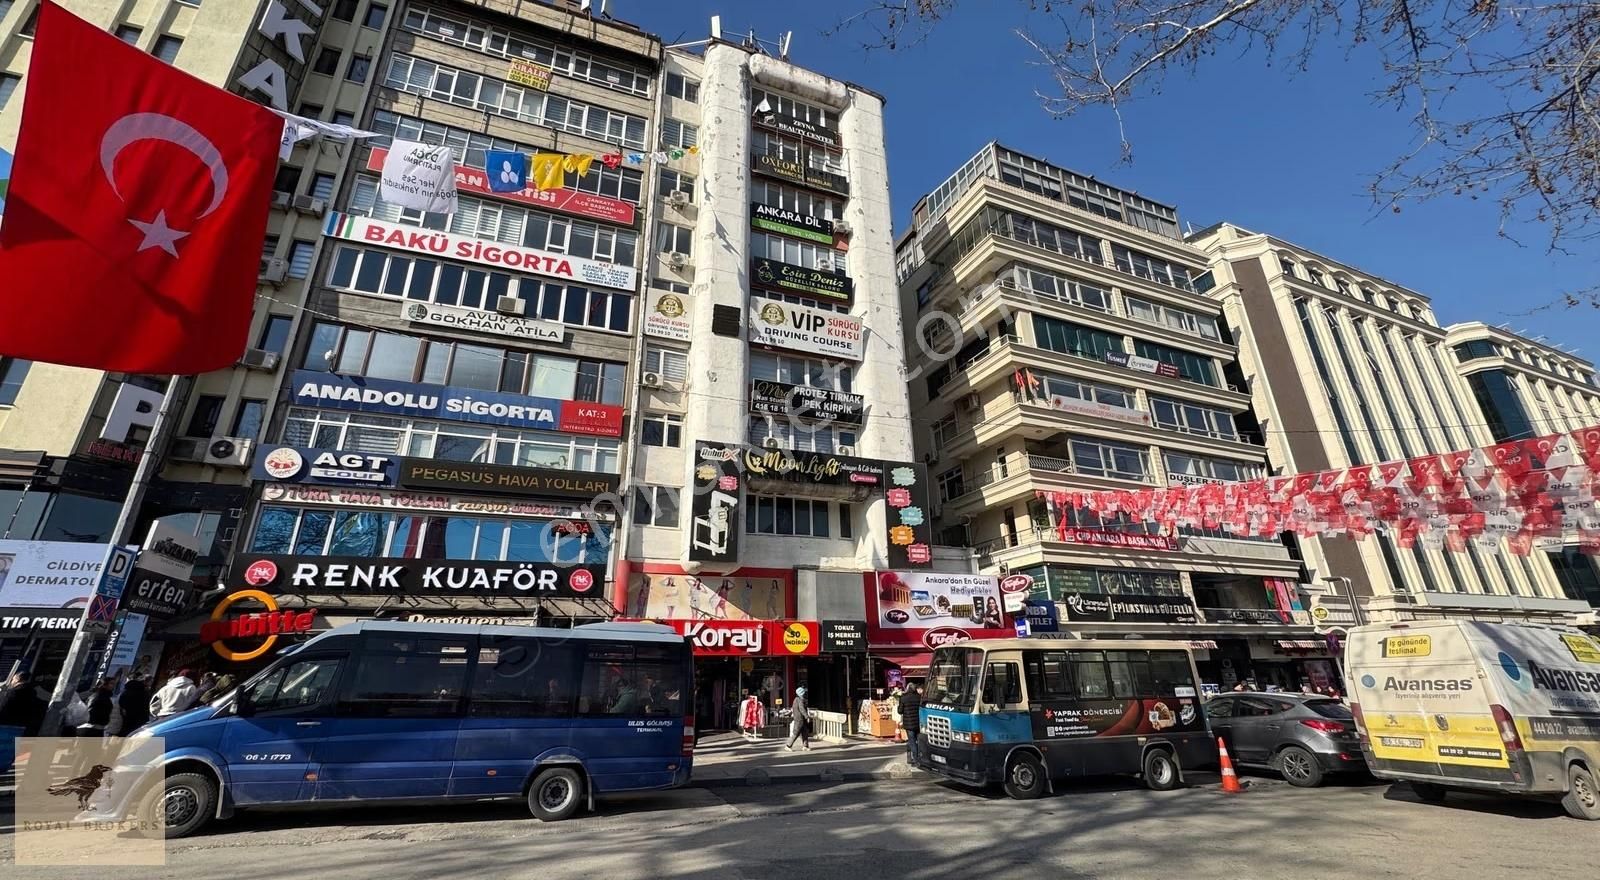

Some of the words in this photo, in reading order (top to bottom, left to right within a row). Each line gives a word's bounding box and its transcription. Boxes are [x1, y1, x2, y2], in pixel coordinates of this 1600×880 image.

[511, 61, 549, 79] KIRALIK
[778, 122, 806, 136] BEAUTY
[806, 131, 835, 145] CENTER
[793, 120, 816, 132] ZEYNA
[756, 204, 802, 223] ANKARA
[805, 215, 822, 228] DİL
[364, 223, 450, 253] BAKÜ
[455, 240, 574, 277] SİGORTA
[781, 266, 807, 280] Esin
[810, 272, 845, 288] Deniz
[430, 313, 506, 331] GÖKHAN
[514, 326, 559, 339] ATİLA
[466, 311, 530, 326] AVUKAT
[648, 316, 670, 325] SÜRÜCÜ
[671, 321, 690, 329] KURSU
[791, 310, 826, 333] VİP
[828, 317, 860, 332] SÜRÜCÜ
[764, 327, 809, 342] DRIVING
[812, 335, 853, 350] COURSE
[827, 327, 859, 341] KURSU
[298, 383, 438, 411] ANADOLU
[446, 395, 555, 423] SİGORTA
[794, 386, 828, 399] PROTEZ
[829, 391, 861, 404] TIRNAK
[100, 382, 166, 443] P
[578, 408, 607, 419] KAT:3
[801, 397, 822, 410] İPEK
[823, 402, 853, 415] KİRPİK
[815, 411, 831, 419] KAT
[313, 452, 389, 470] AGT
[763, 451, 805, 474] Moon
[807, 455, 841, 481] Light
[322, 469, 379, 480] tour
[411, 467, 496, 485] PEGASUS
[498, 472, 541, 488] HAVA
[543, 476, 610, 494] YOLLARI
[288, 487, 334, 503] TÜRK
[338, 489, 385, 506] HAVA
[1076, 531, 1091, 542] CHP
[1091, 533, 1120, 544] ANKARA
[1127, 536, 1167, 549] BAŞKANLIĞI
[47, 560, 103, 572] CİLDİYE
[111, 554, 127, 574] D
[15, 575, 96, 586] DERMATOL
[292, 563, 404, 589] RENK
[422, 562, 558, 591] KUAFÖR
[925, 576, 963, 585] Ankara'dan
[964, 577, 973, 585] En
[972, 577, 992, 586] Güzel
[138, 580, 185, 606] erfen
[1112, 603, 1154, 614] EPİLASYON
[1160, 604, 1195, 615] GÜZELLİK
[2, 616, 31, 629] TIP
[31, 617, 81, 629] MERK
[1028, 617, 1053, 626] UTLET
[684, 622, 764, 653] Koray
[784, 638, 809, 646] İNDİRİM
[827, 631, 835, 639] İŞ
[835, 631, 861, 639] MERKEZİ
[1377, 637, 1388, 658] 1
[1389, 640, 1396, 648] iş
[1397, 638, 1428, 648] gününde
[1389, 647, 1417, 655] teslimat
[1384, 676, 1473, 691] Avansas
[1527, 659, 1600, 693] Avansa
[1053, 709, 1082, 717] YAPRAK
[1083, 707, 1123, 717] DÖNERCİSİ
[1533, 721, 1546, 735] 444
[1554, 722, 1564, 735] 22
[270, 753, 292, 761] 1773
[1467, 750, 1501, 758] avansas.com
